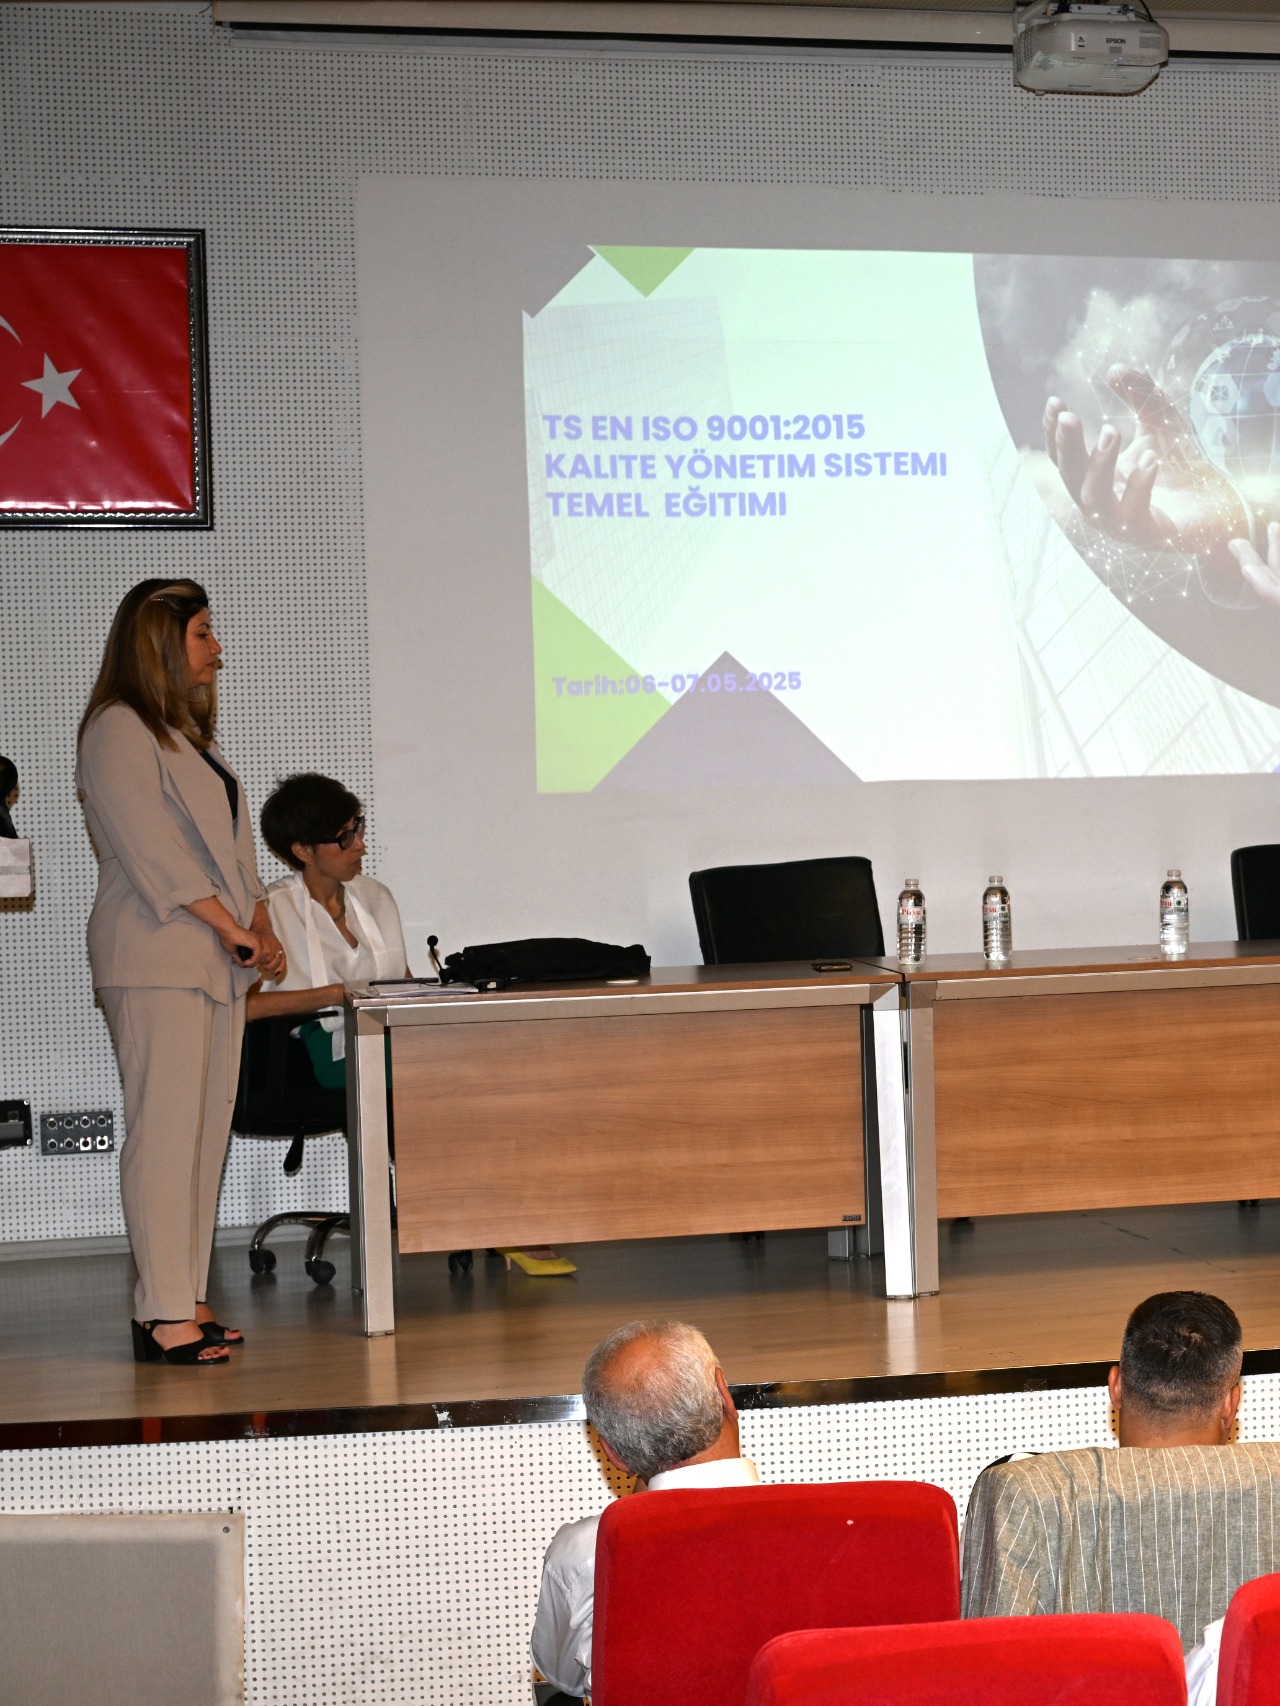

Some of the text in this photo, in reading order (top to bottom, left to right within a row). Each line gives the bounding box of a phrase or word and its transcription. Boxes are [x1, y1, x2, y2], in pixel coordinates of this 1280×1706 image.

[542, 414, 865, 441] TS EN ISO 9001:2015
[545, 448, 947, 479] KALITE YÖNETIM SISTEMI
[545, 485, 787, 517] TEMEL EĞITIMI
[552, 671, 802, 698] Tarih:06-07.05.2025
